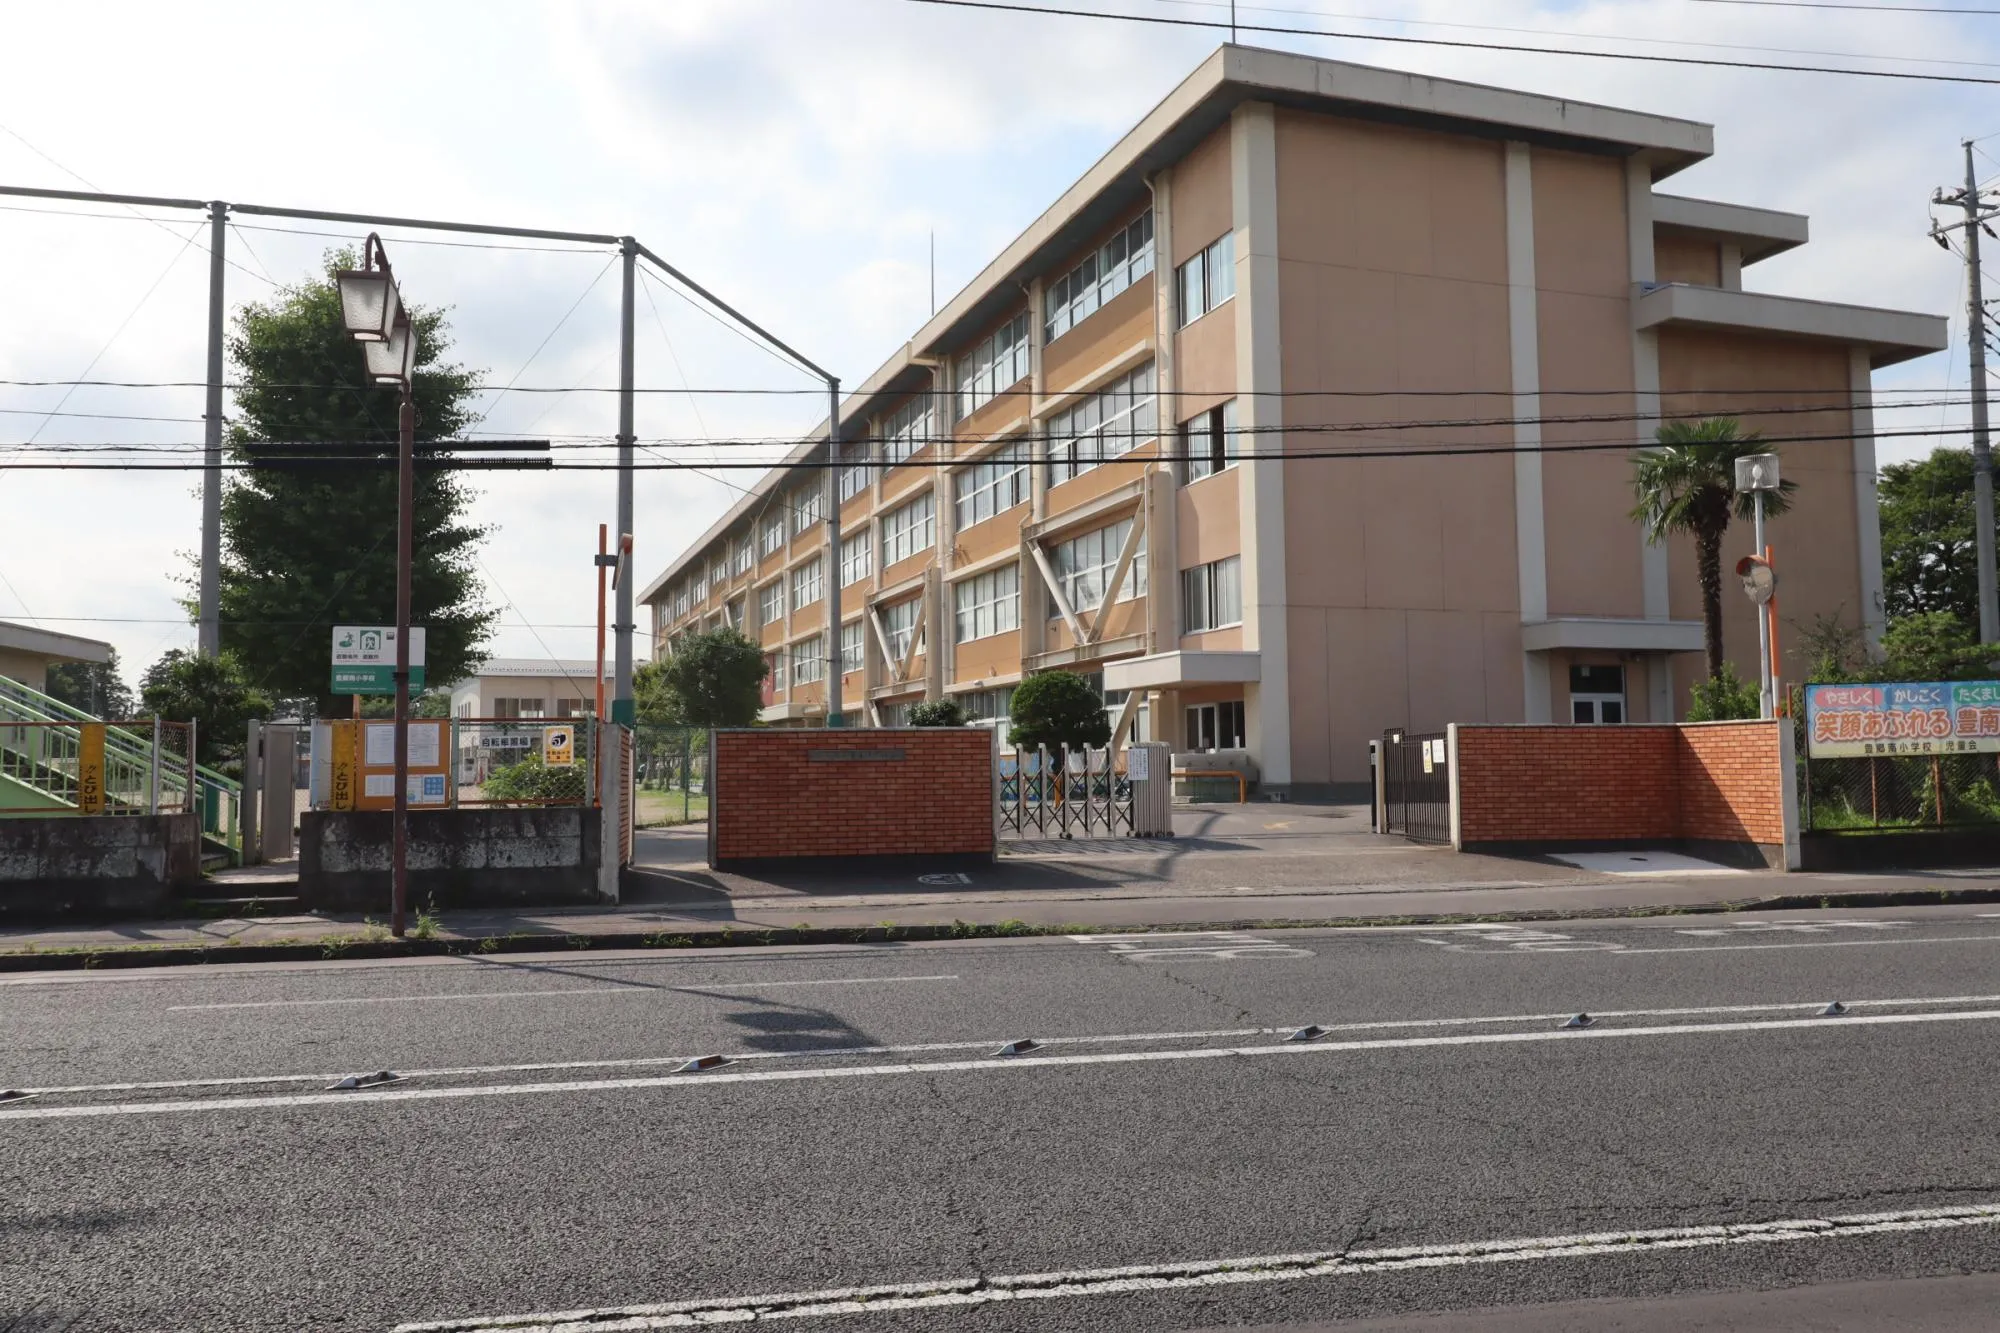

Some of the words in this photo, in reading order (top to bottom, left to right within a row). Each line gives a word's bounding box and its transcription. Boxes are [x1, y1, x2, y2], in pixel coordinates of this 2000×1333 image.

[1825, 690, 1873, 705] やさしく
[1894, 688, 1941, 703] かしこく
[1816, 710, 1950, 739] 笑顔あふれる
[1864, 742, 1932, 754] 豊郷南小学校
[1945, 740, 1977, 752] 児童会
